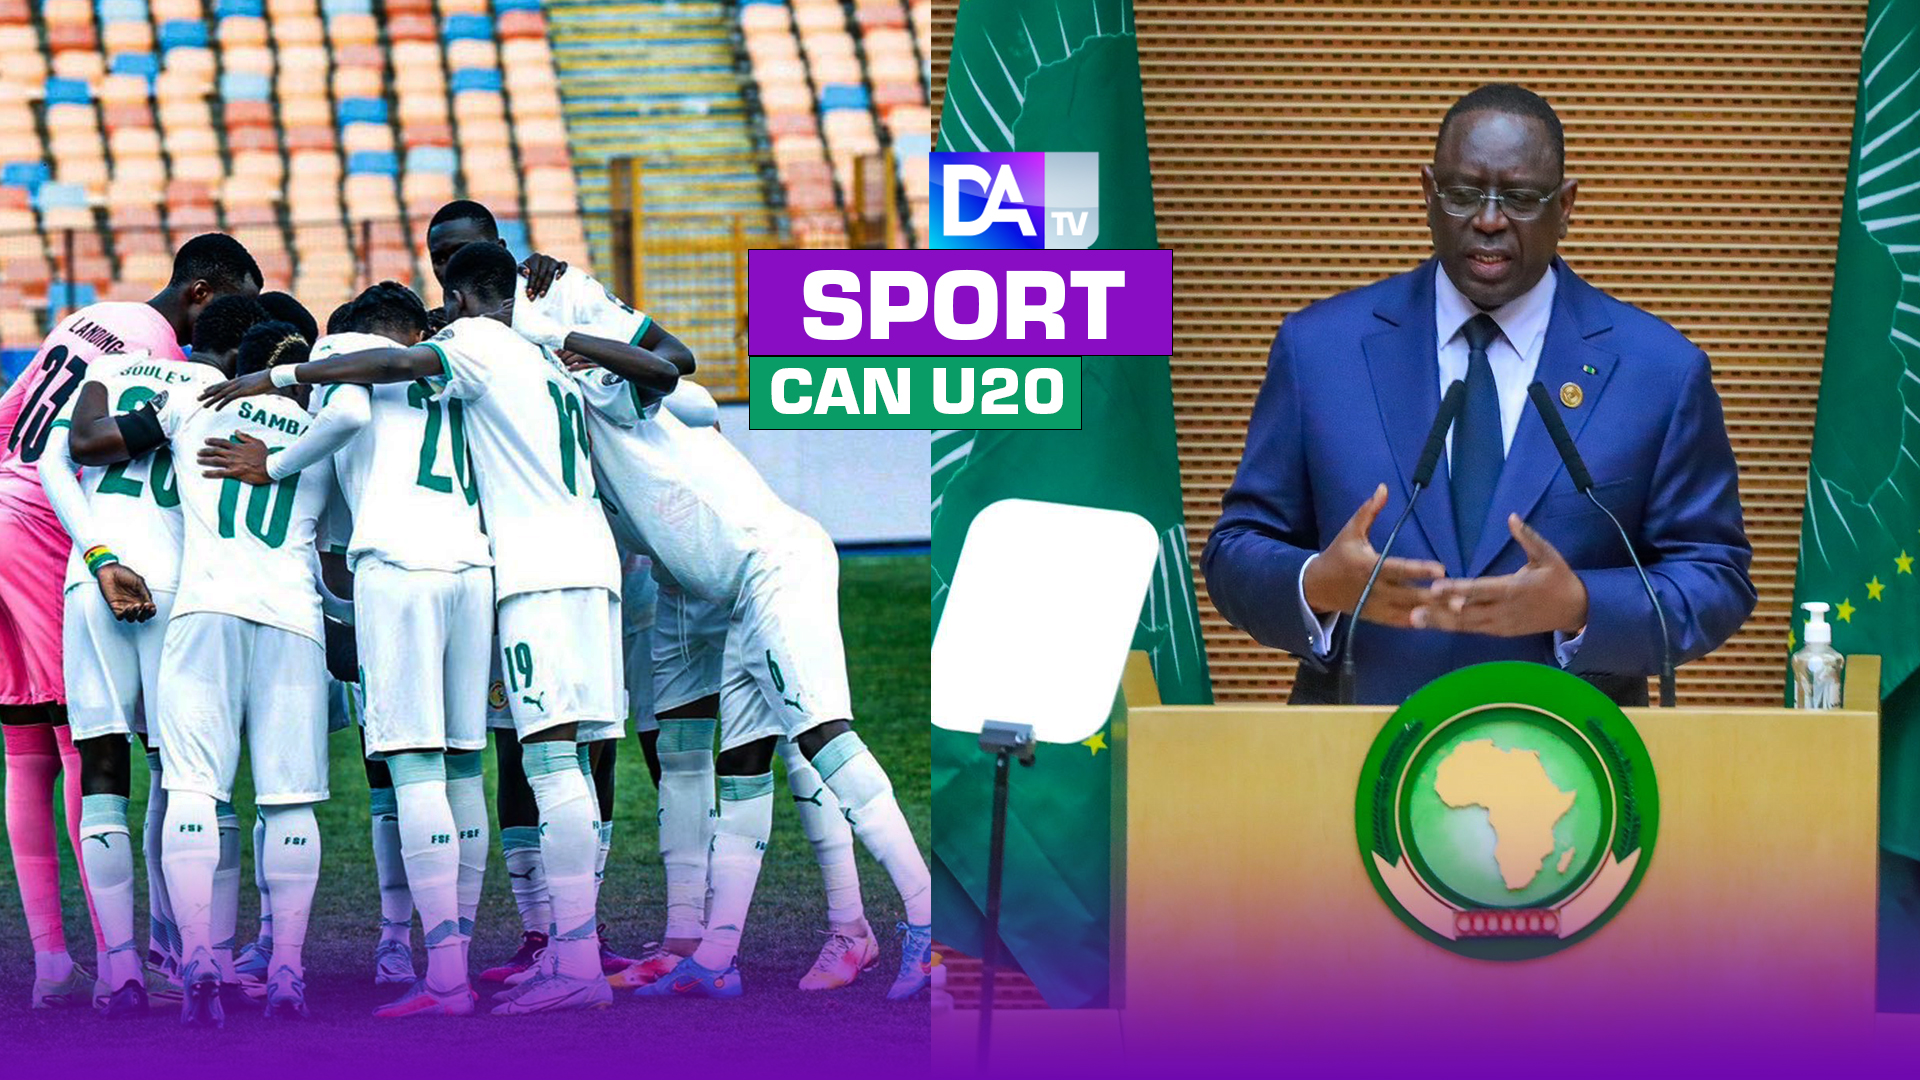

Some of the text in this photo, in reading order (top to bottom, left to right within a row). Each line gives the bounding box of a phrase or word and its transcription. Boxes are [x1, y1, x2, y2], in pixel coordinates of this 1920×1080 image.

[8, 345, 88, 463] 23
[504, 642, 533, 693] 19
[766, 649, 785, 693] 6
[431, 834, 450, 844] FSF
[460, 828, 480, 840] FSF
